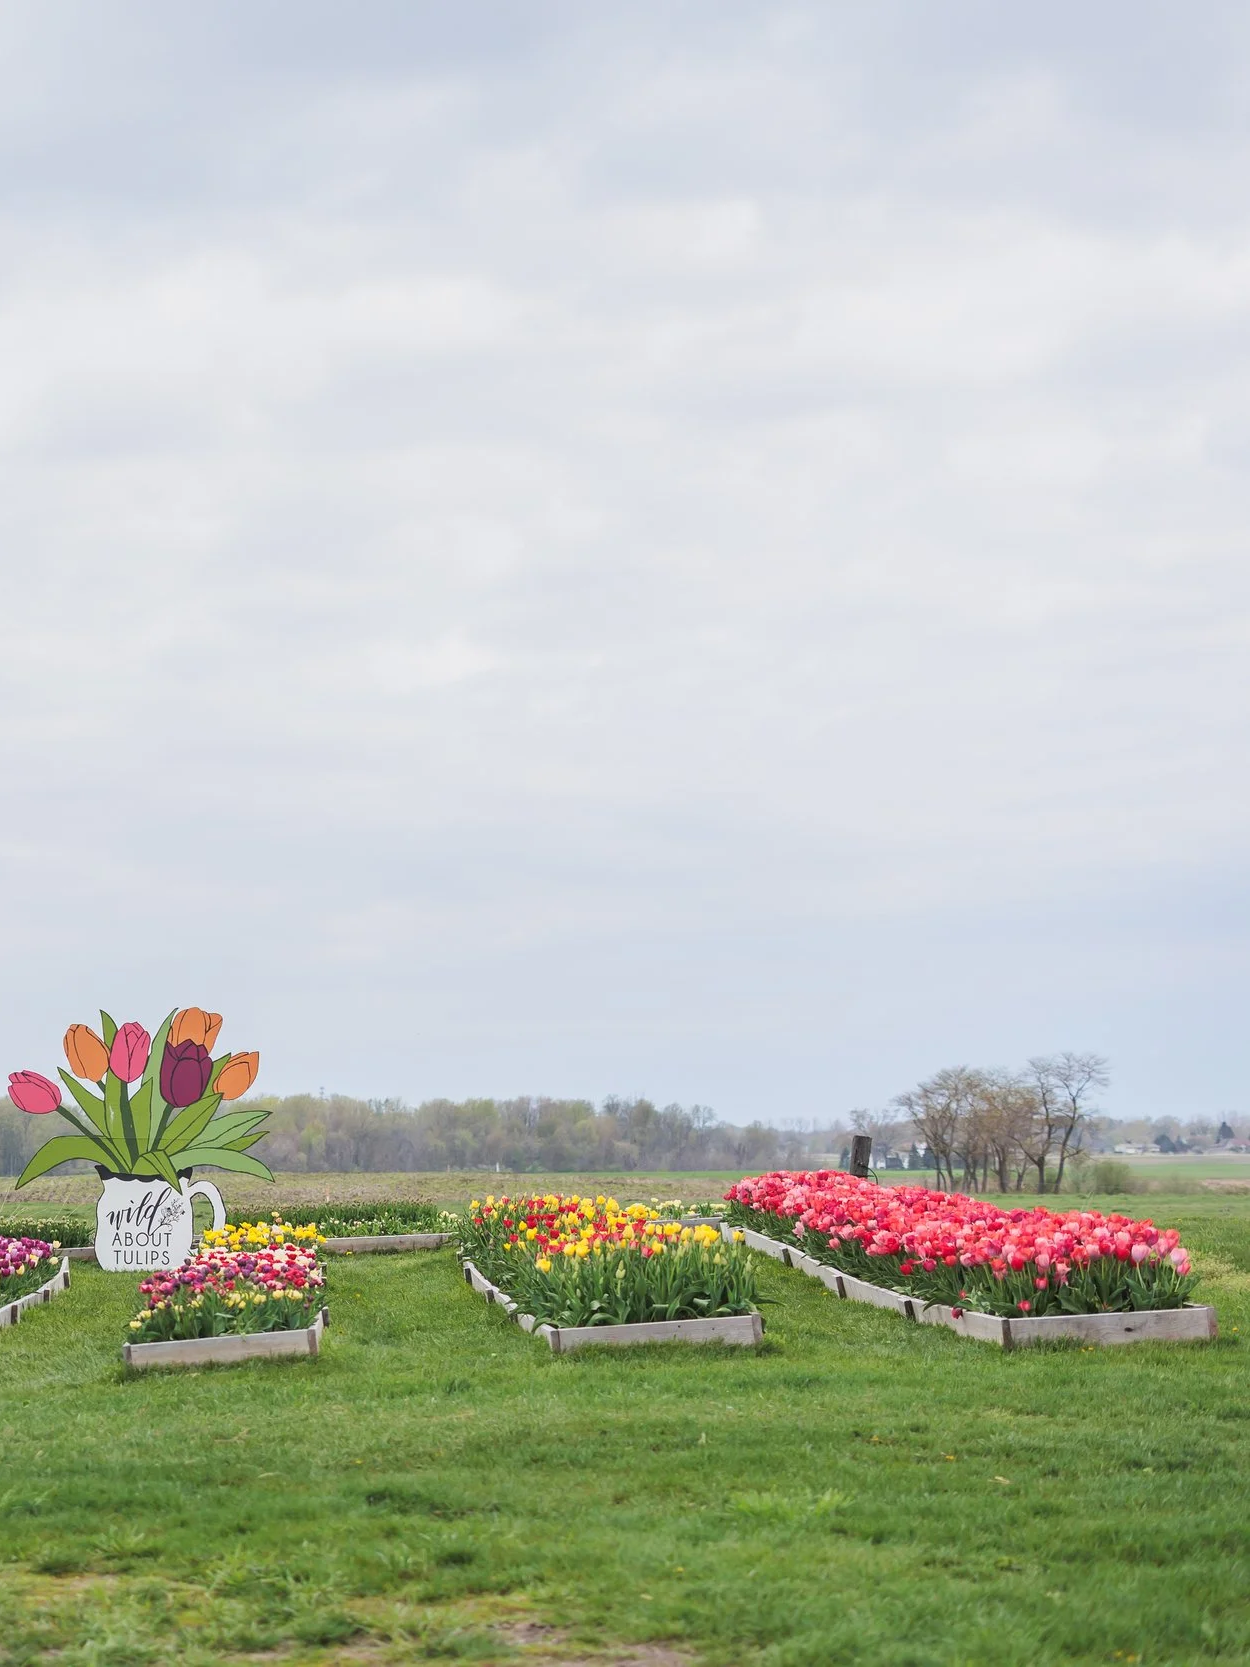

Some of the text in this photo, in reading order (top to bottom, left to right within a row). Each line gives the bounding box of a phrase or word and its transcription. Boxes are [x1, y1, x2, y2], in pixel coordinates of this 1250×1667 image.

[106, 1187, 173, 1237] wild
[111, 1232, 172, 1247] ABOUT
[113, 1250, 170, 1266] TULIPS
